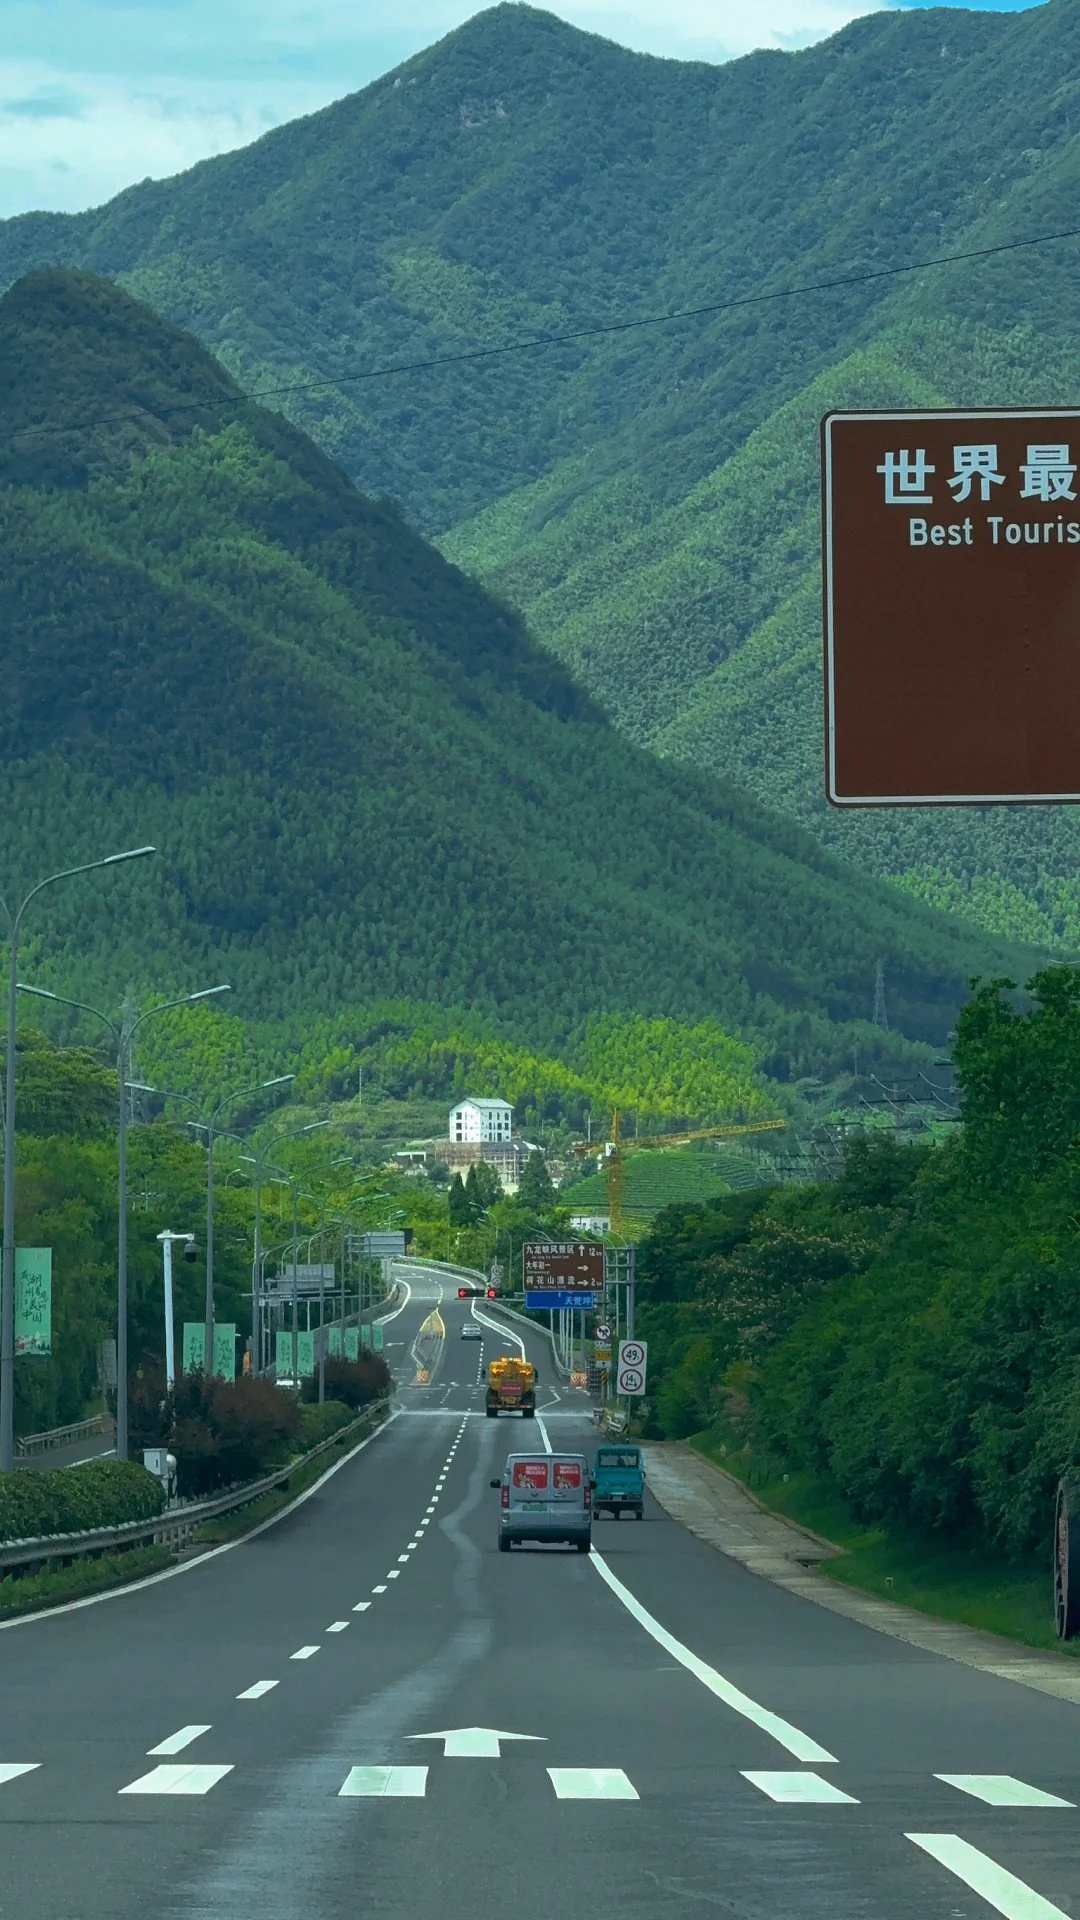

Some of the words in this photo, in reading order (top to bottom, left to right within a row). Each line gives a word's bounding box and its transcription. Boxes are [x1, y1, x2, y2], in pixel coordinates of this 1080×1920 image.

[876, 444, 1078, 504] 世界最
[909, 517, 973, 546] Best
[565, 1296, 592, 1306] 天荒坪
